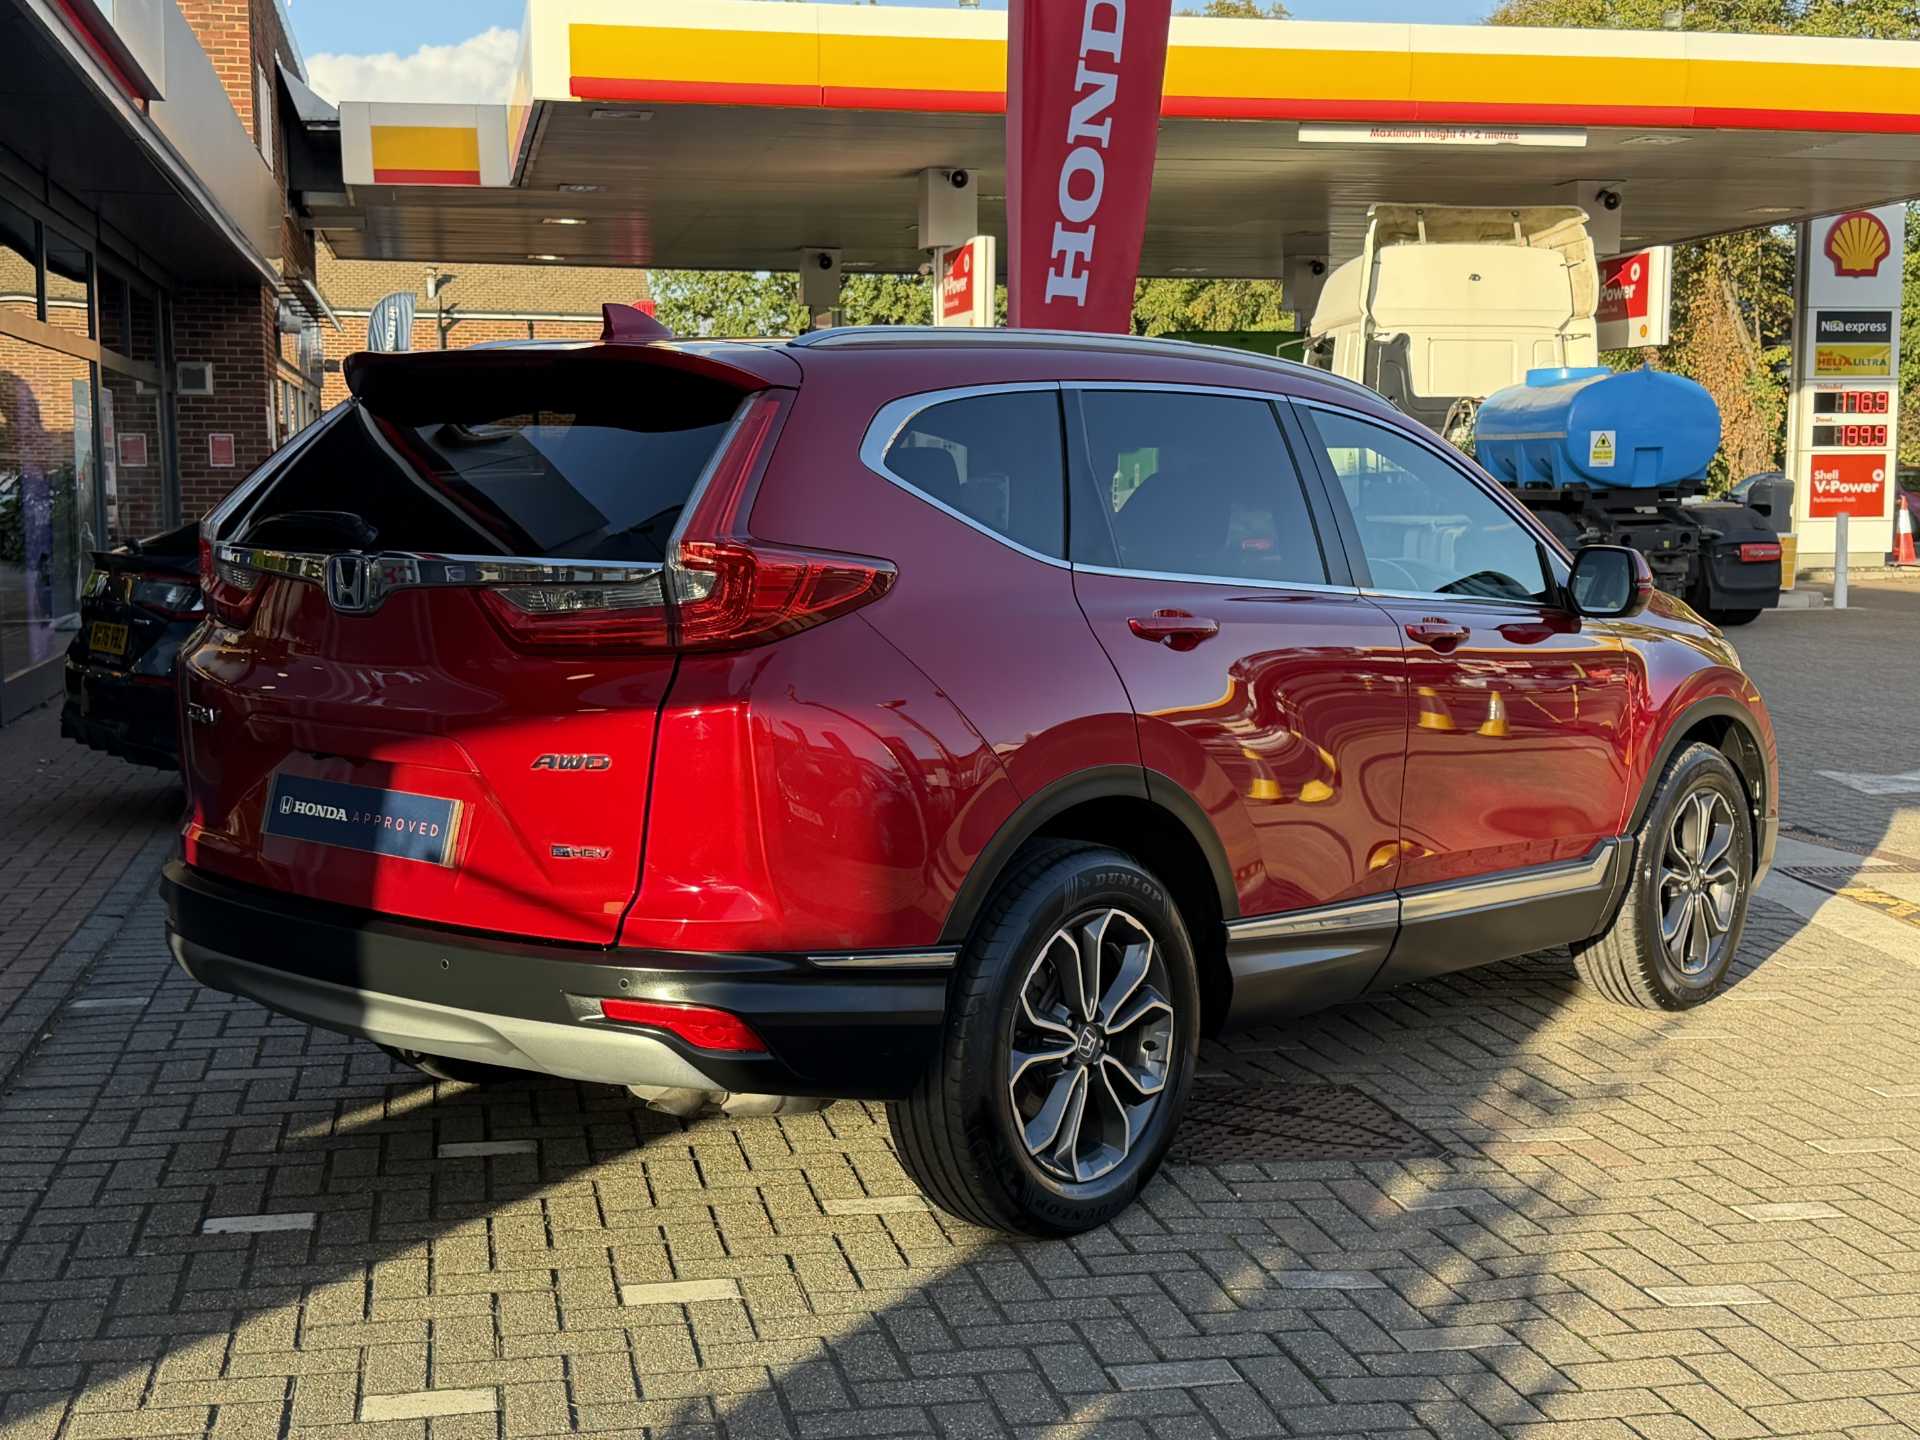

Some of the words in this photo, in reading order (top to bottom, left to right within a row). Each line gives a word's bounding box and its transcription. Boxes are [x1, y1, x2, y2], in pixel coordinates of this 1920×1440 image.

[1370, 128, 1421, 138] Maximum
[1424, 128, 1456, 141] height
[1484, 130, 1519, 140] metres
[1045, 0, 1126, 307] HOND
[1600, 284, 1636, 302] Power
[1821, 321, 1844, 332] Nisa
[1845, 323, 1887, 334] express
[1853, 358, 1887, 367] ULTRA
[1842, 392, 1887, 412] 176.9
[1814, 469, 1839, 480] Shell
[1814, 480, 1879, 494] V-Power
[530, 753, 612, 772] AWD
[293, 801, 348, 821] HONDA
[352, 811, 440, 837] APPROVED
[1095, 872, 1162, 902] DUNLOP
